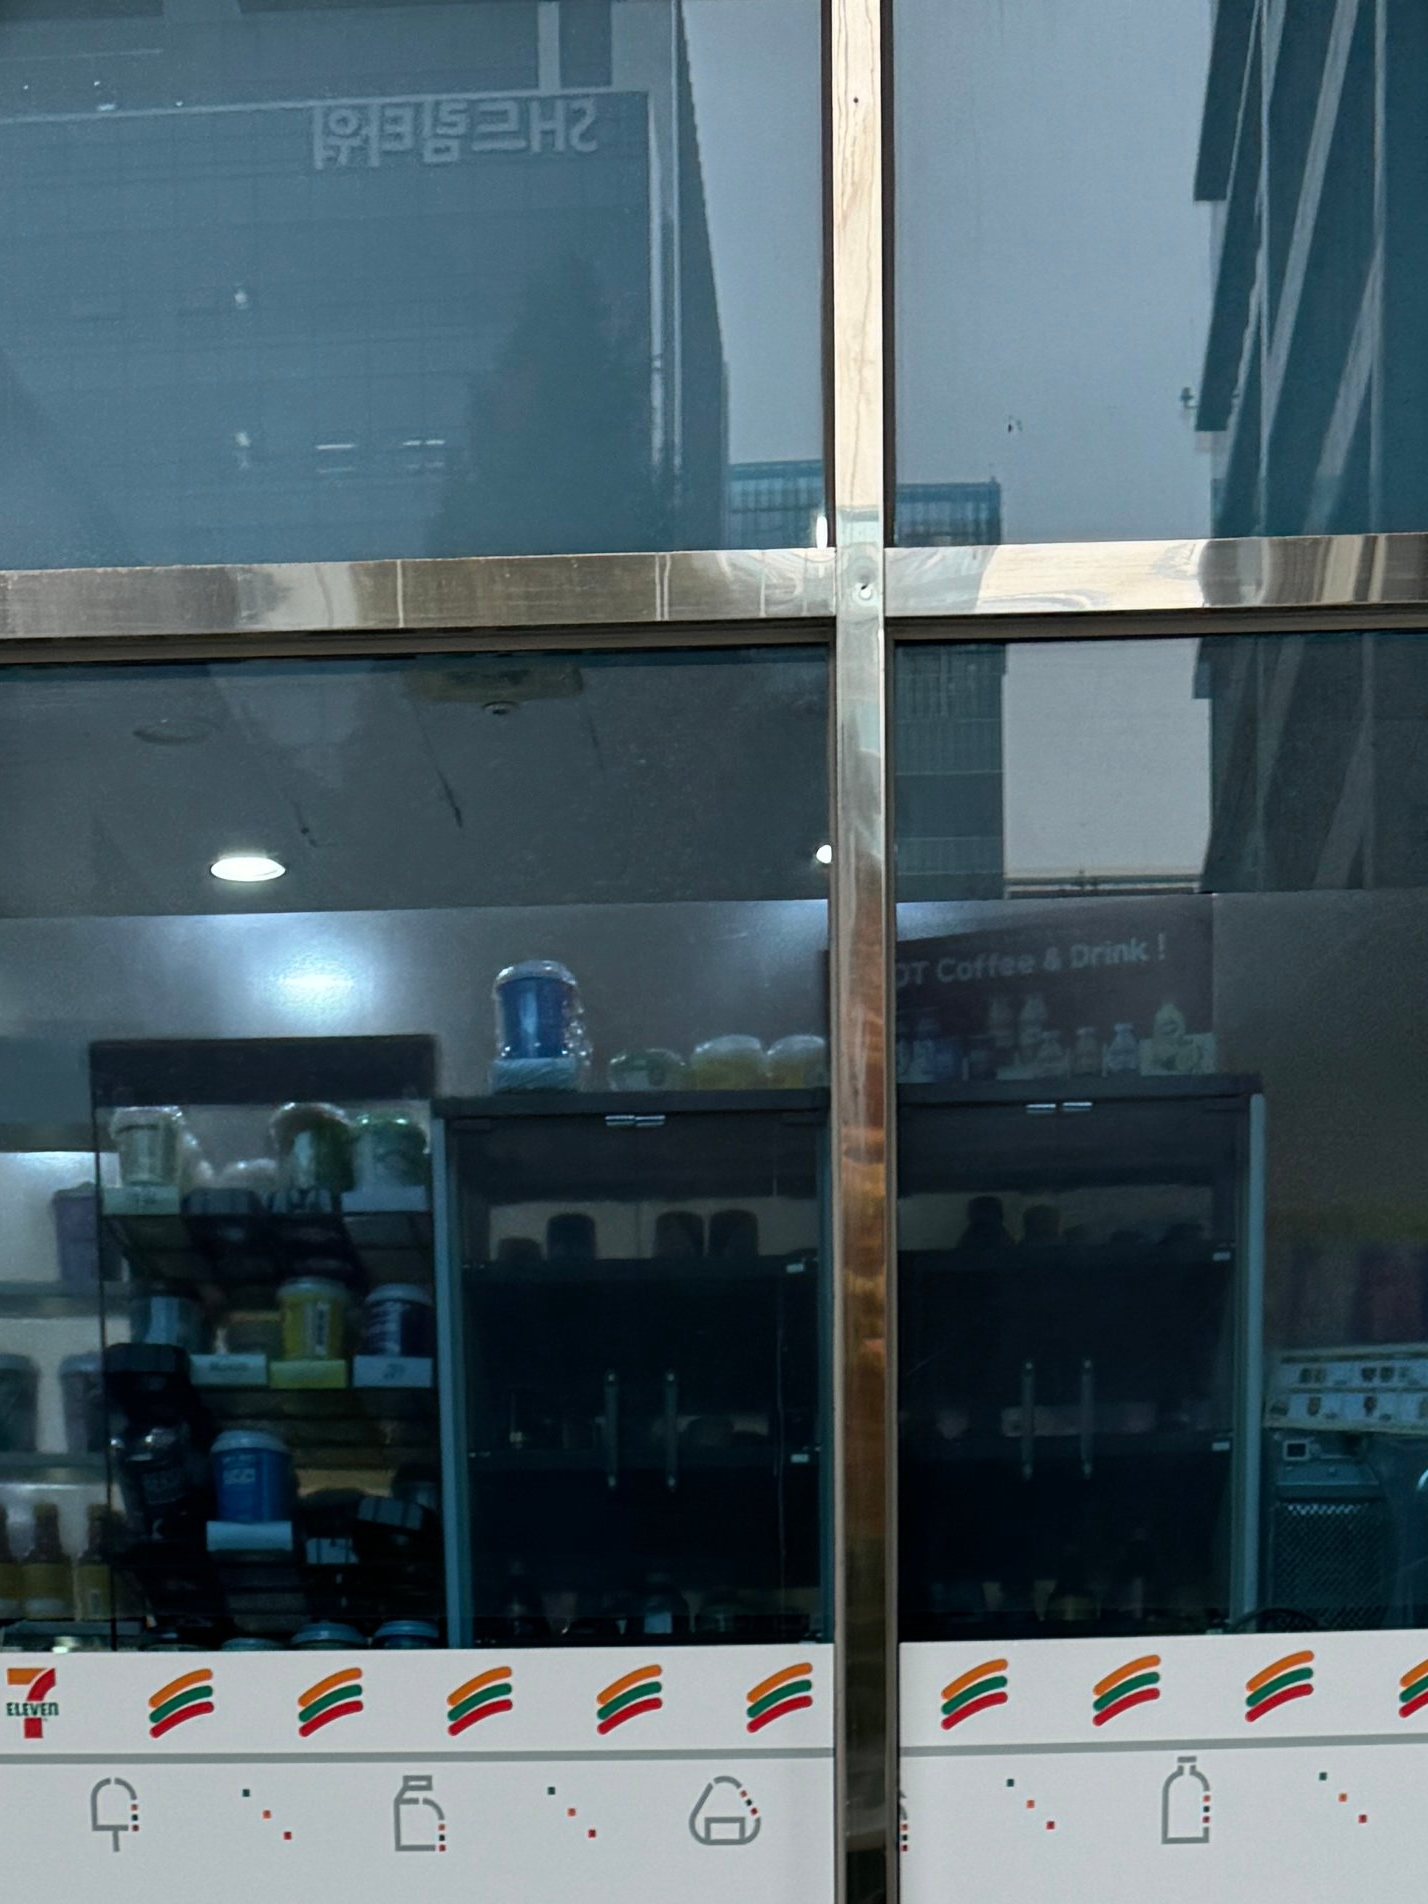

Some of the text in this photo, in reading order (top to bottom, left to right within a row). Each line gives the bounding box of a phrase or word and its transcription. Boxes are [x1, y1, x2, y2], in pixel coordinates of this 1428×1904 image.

[936, 953, 1036, 983] Coffee
[1043, 946, 1063, 972] &
[1072, 937, 1149, 969] Drink
